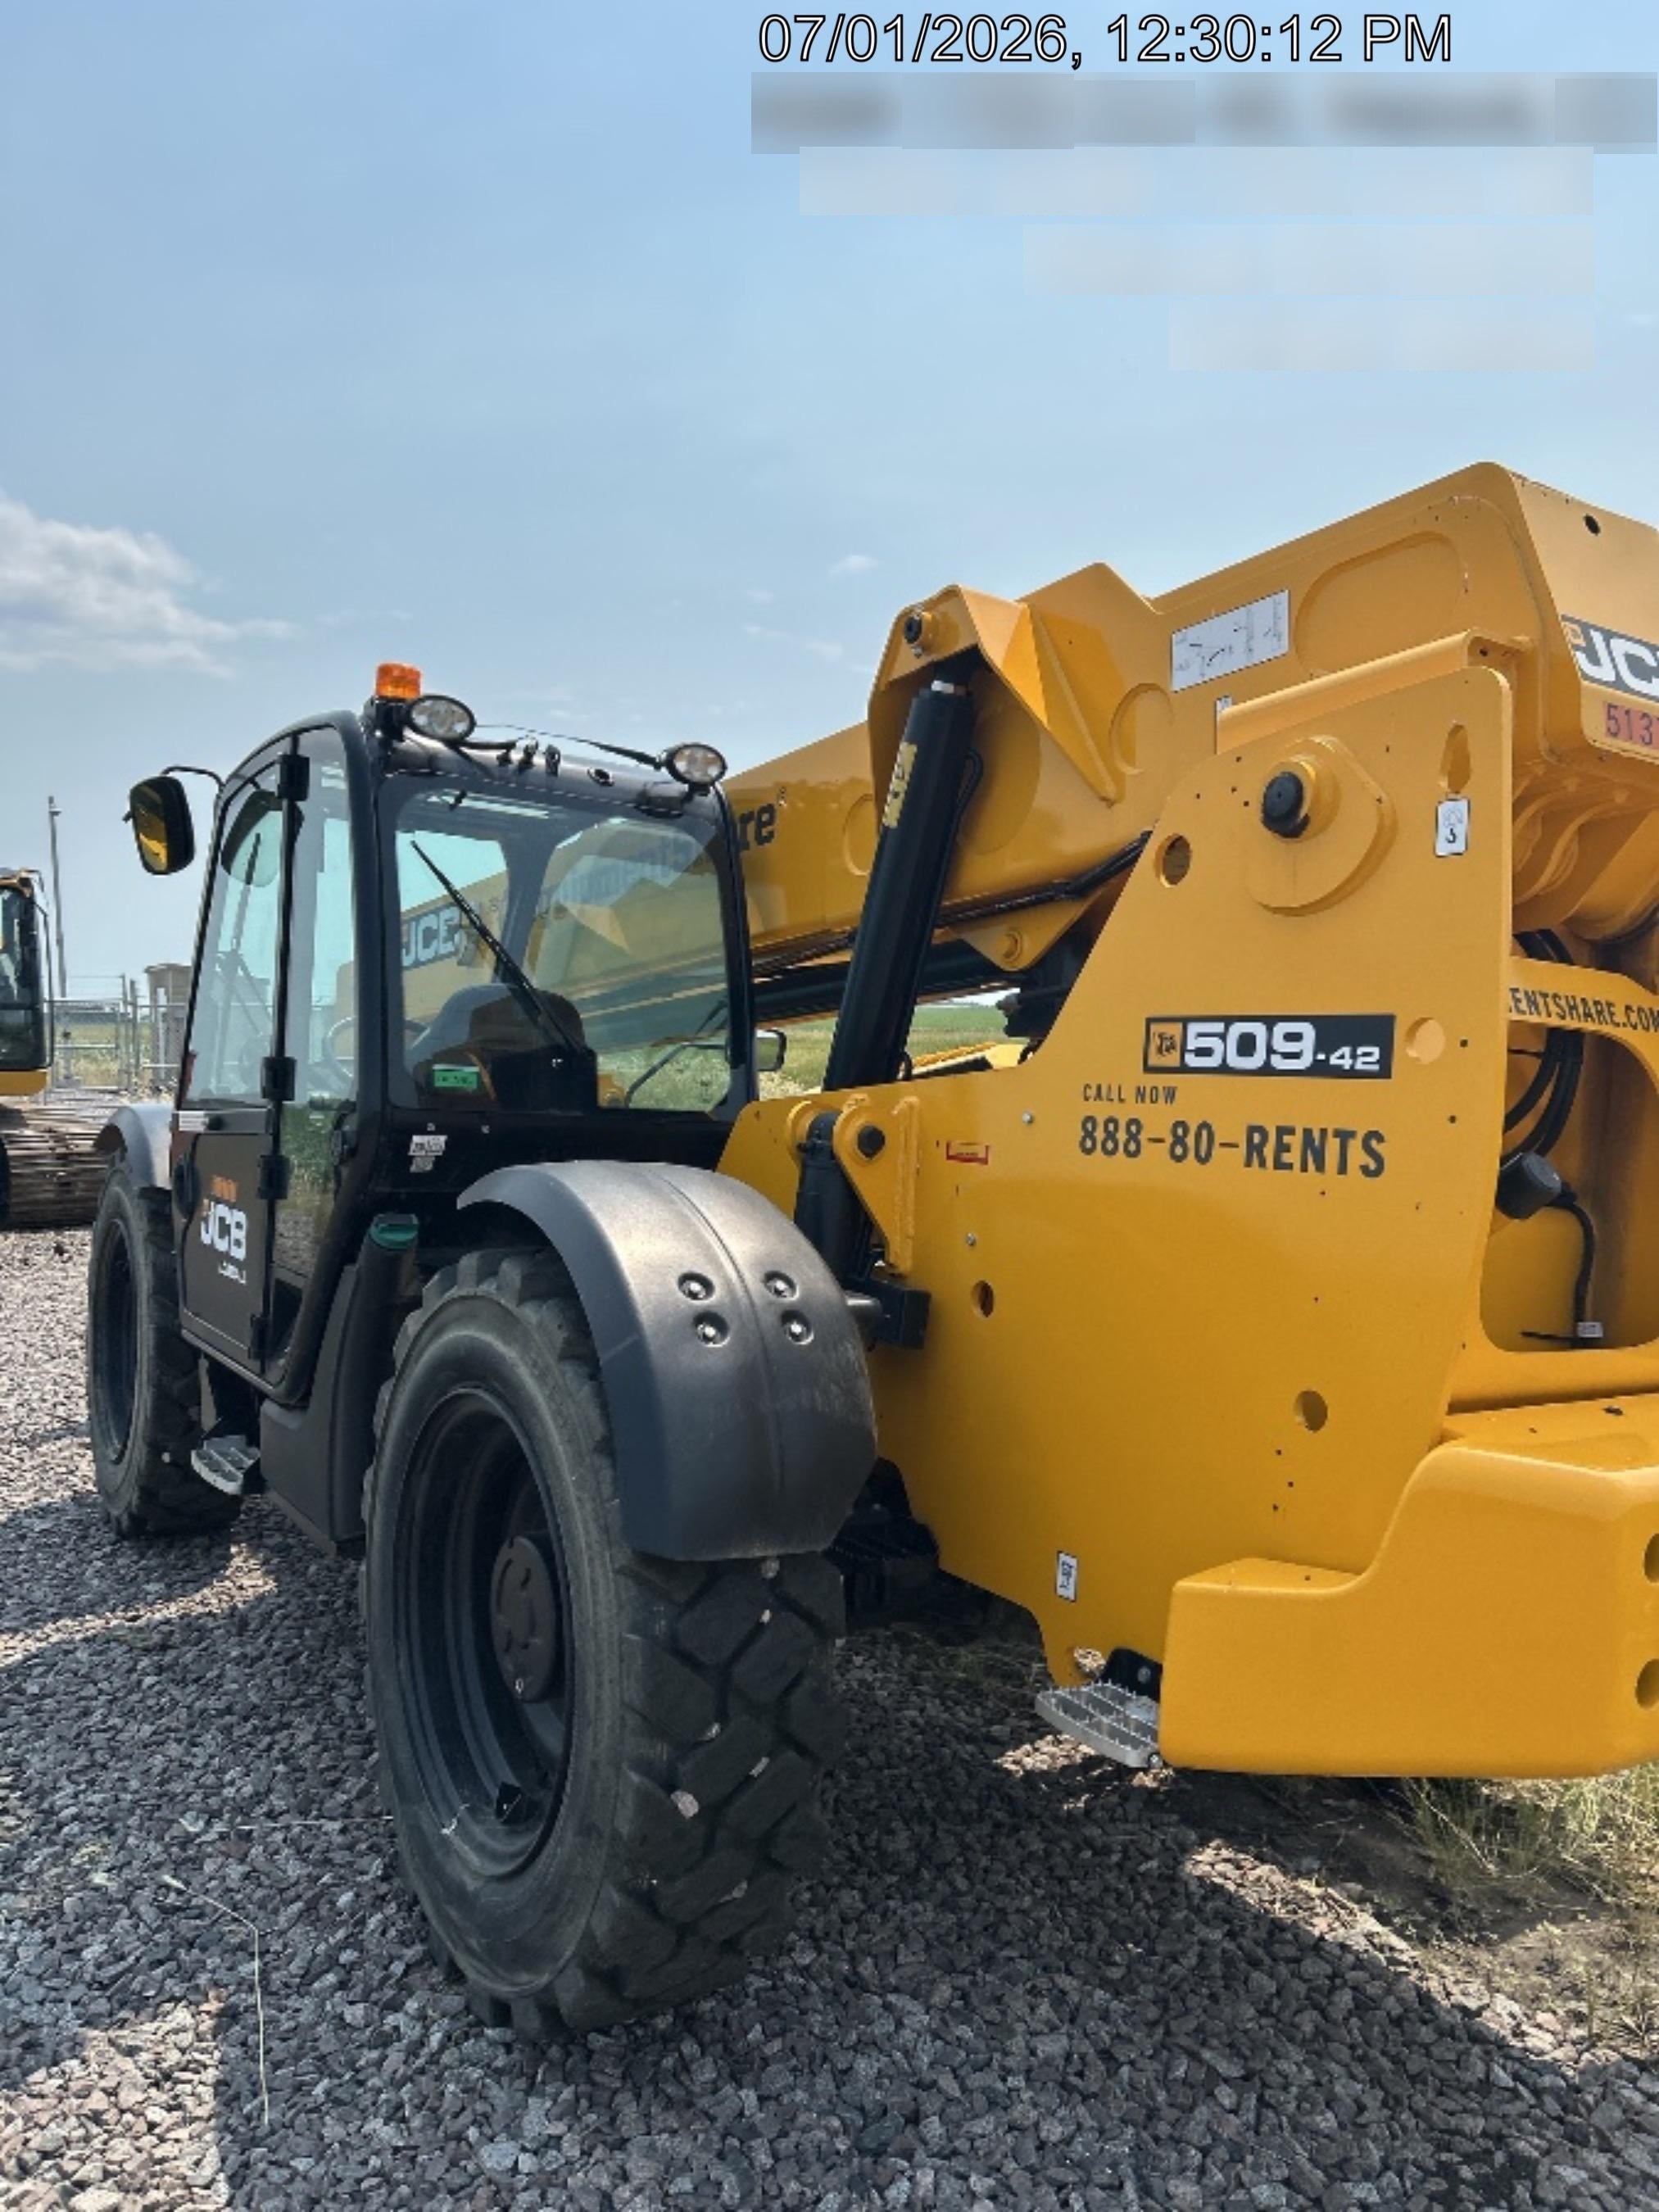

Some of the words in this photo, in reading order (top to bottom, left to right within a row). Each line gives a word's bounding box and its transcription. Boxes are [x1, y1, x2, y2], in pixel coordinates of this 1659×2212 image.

[1575, 628, 1659, 698] JC
[1606, 702, 1659, 746] 513
[1184, 1021, 1380, 1071] 509-42
[1082, 1083, 1126, 1104] CALL
[1135, 1086, 1178, 1105] NOW
[1079, 1115, 1386, 1179] 888-80-RENTS
[200, 1201, 247, 1262] JCB
